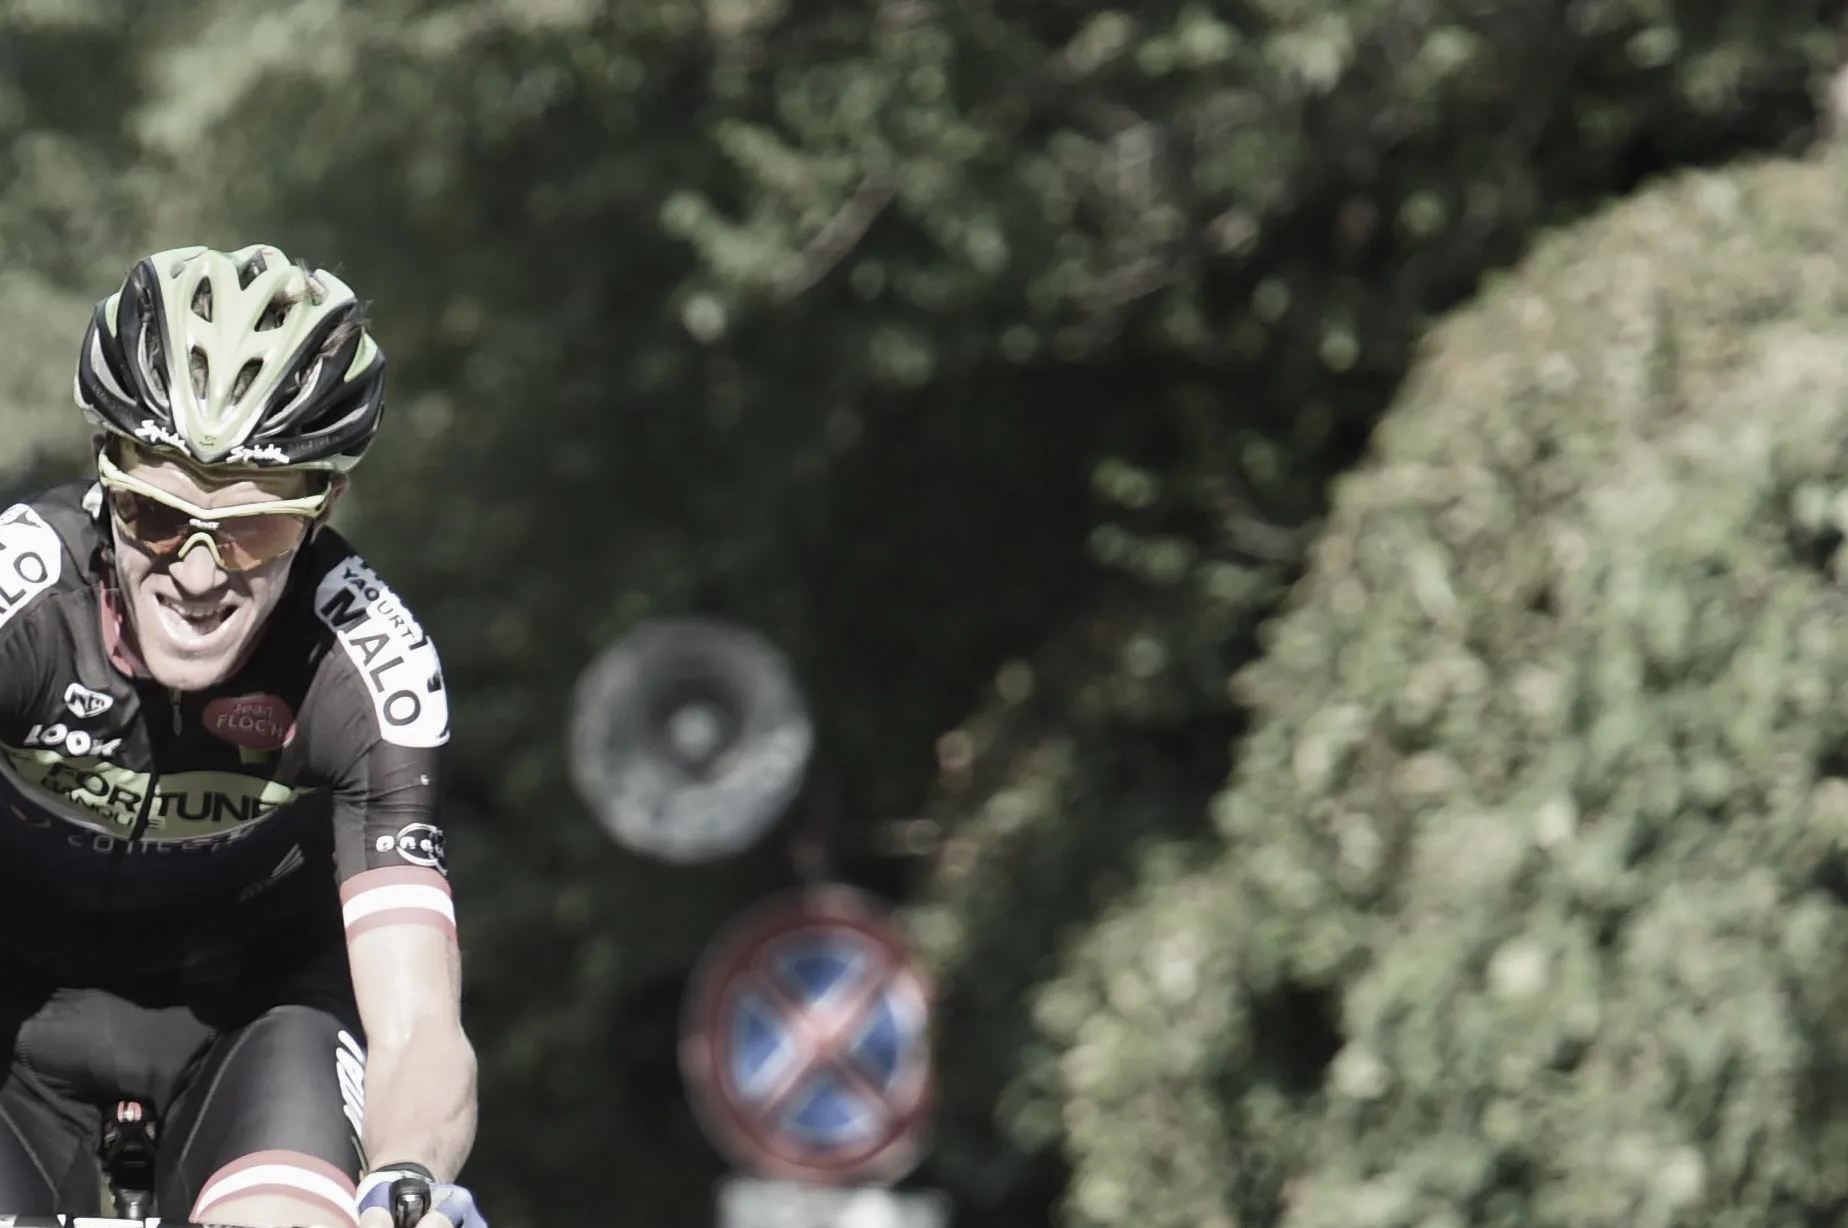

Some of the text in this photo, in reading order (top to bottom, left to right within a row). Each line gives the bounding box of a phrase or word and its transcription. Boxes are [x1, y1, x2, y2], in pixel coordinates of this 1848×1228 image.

[342, 566, 416, 639] YAOURT
[320, 586, 421, 727] MALO
[233, 703, 274, 717] Jean
[23, 722, 123, 756] LOOK
